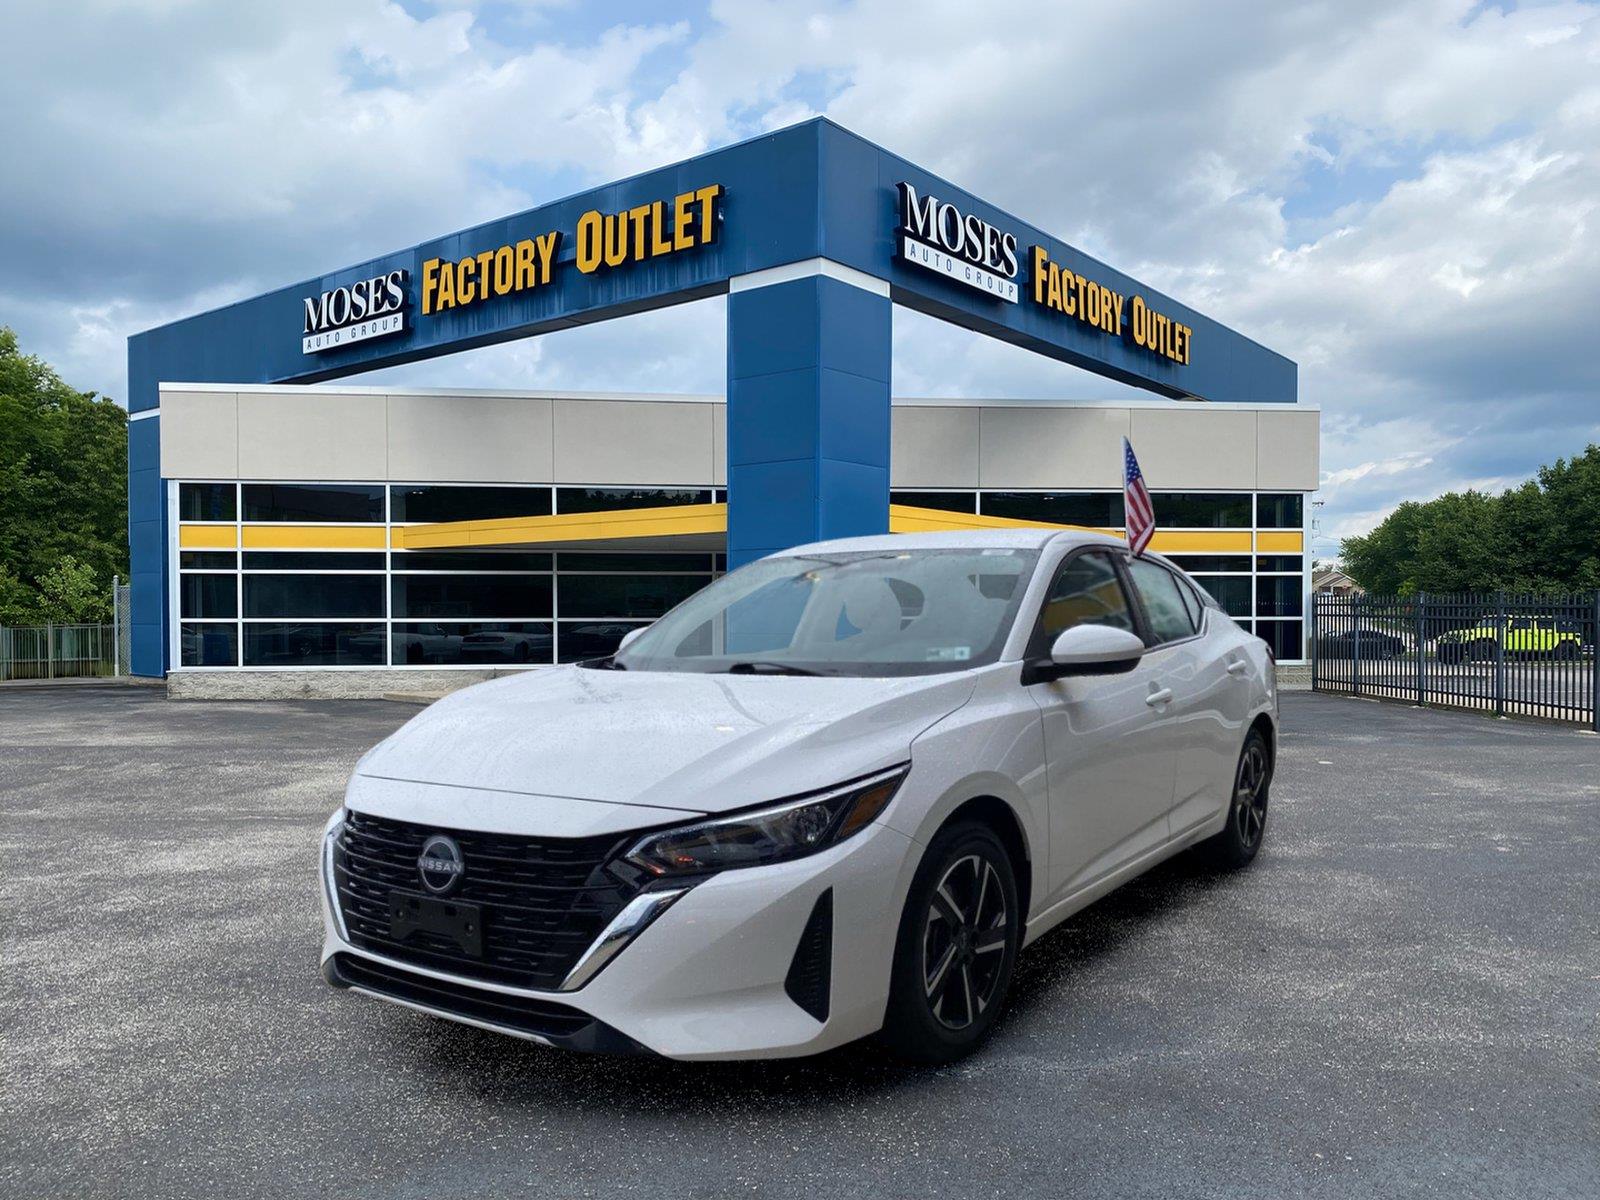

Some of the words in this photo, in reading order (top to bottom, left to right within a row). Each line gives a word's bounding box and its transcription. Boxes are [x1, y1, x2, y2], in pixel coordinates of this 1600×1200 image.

[422, 231, 558, 315] FACTORY
[576, 184, 719, 274] OUTLET
[904, 182, 1018, 278] MOSES
[909, 242, 953, 273] AUTO
[964, 266, 1015, 297] GROUP
[303, 270, 404, 334] MOSES
[306, 332, 341, 351] AUTO
[350, 316, 400, 339] GROUP
[1035, 245, 1124, 336] FACTORY
[1132, 295, 1192, 366] OUTLET
